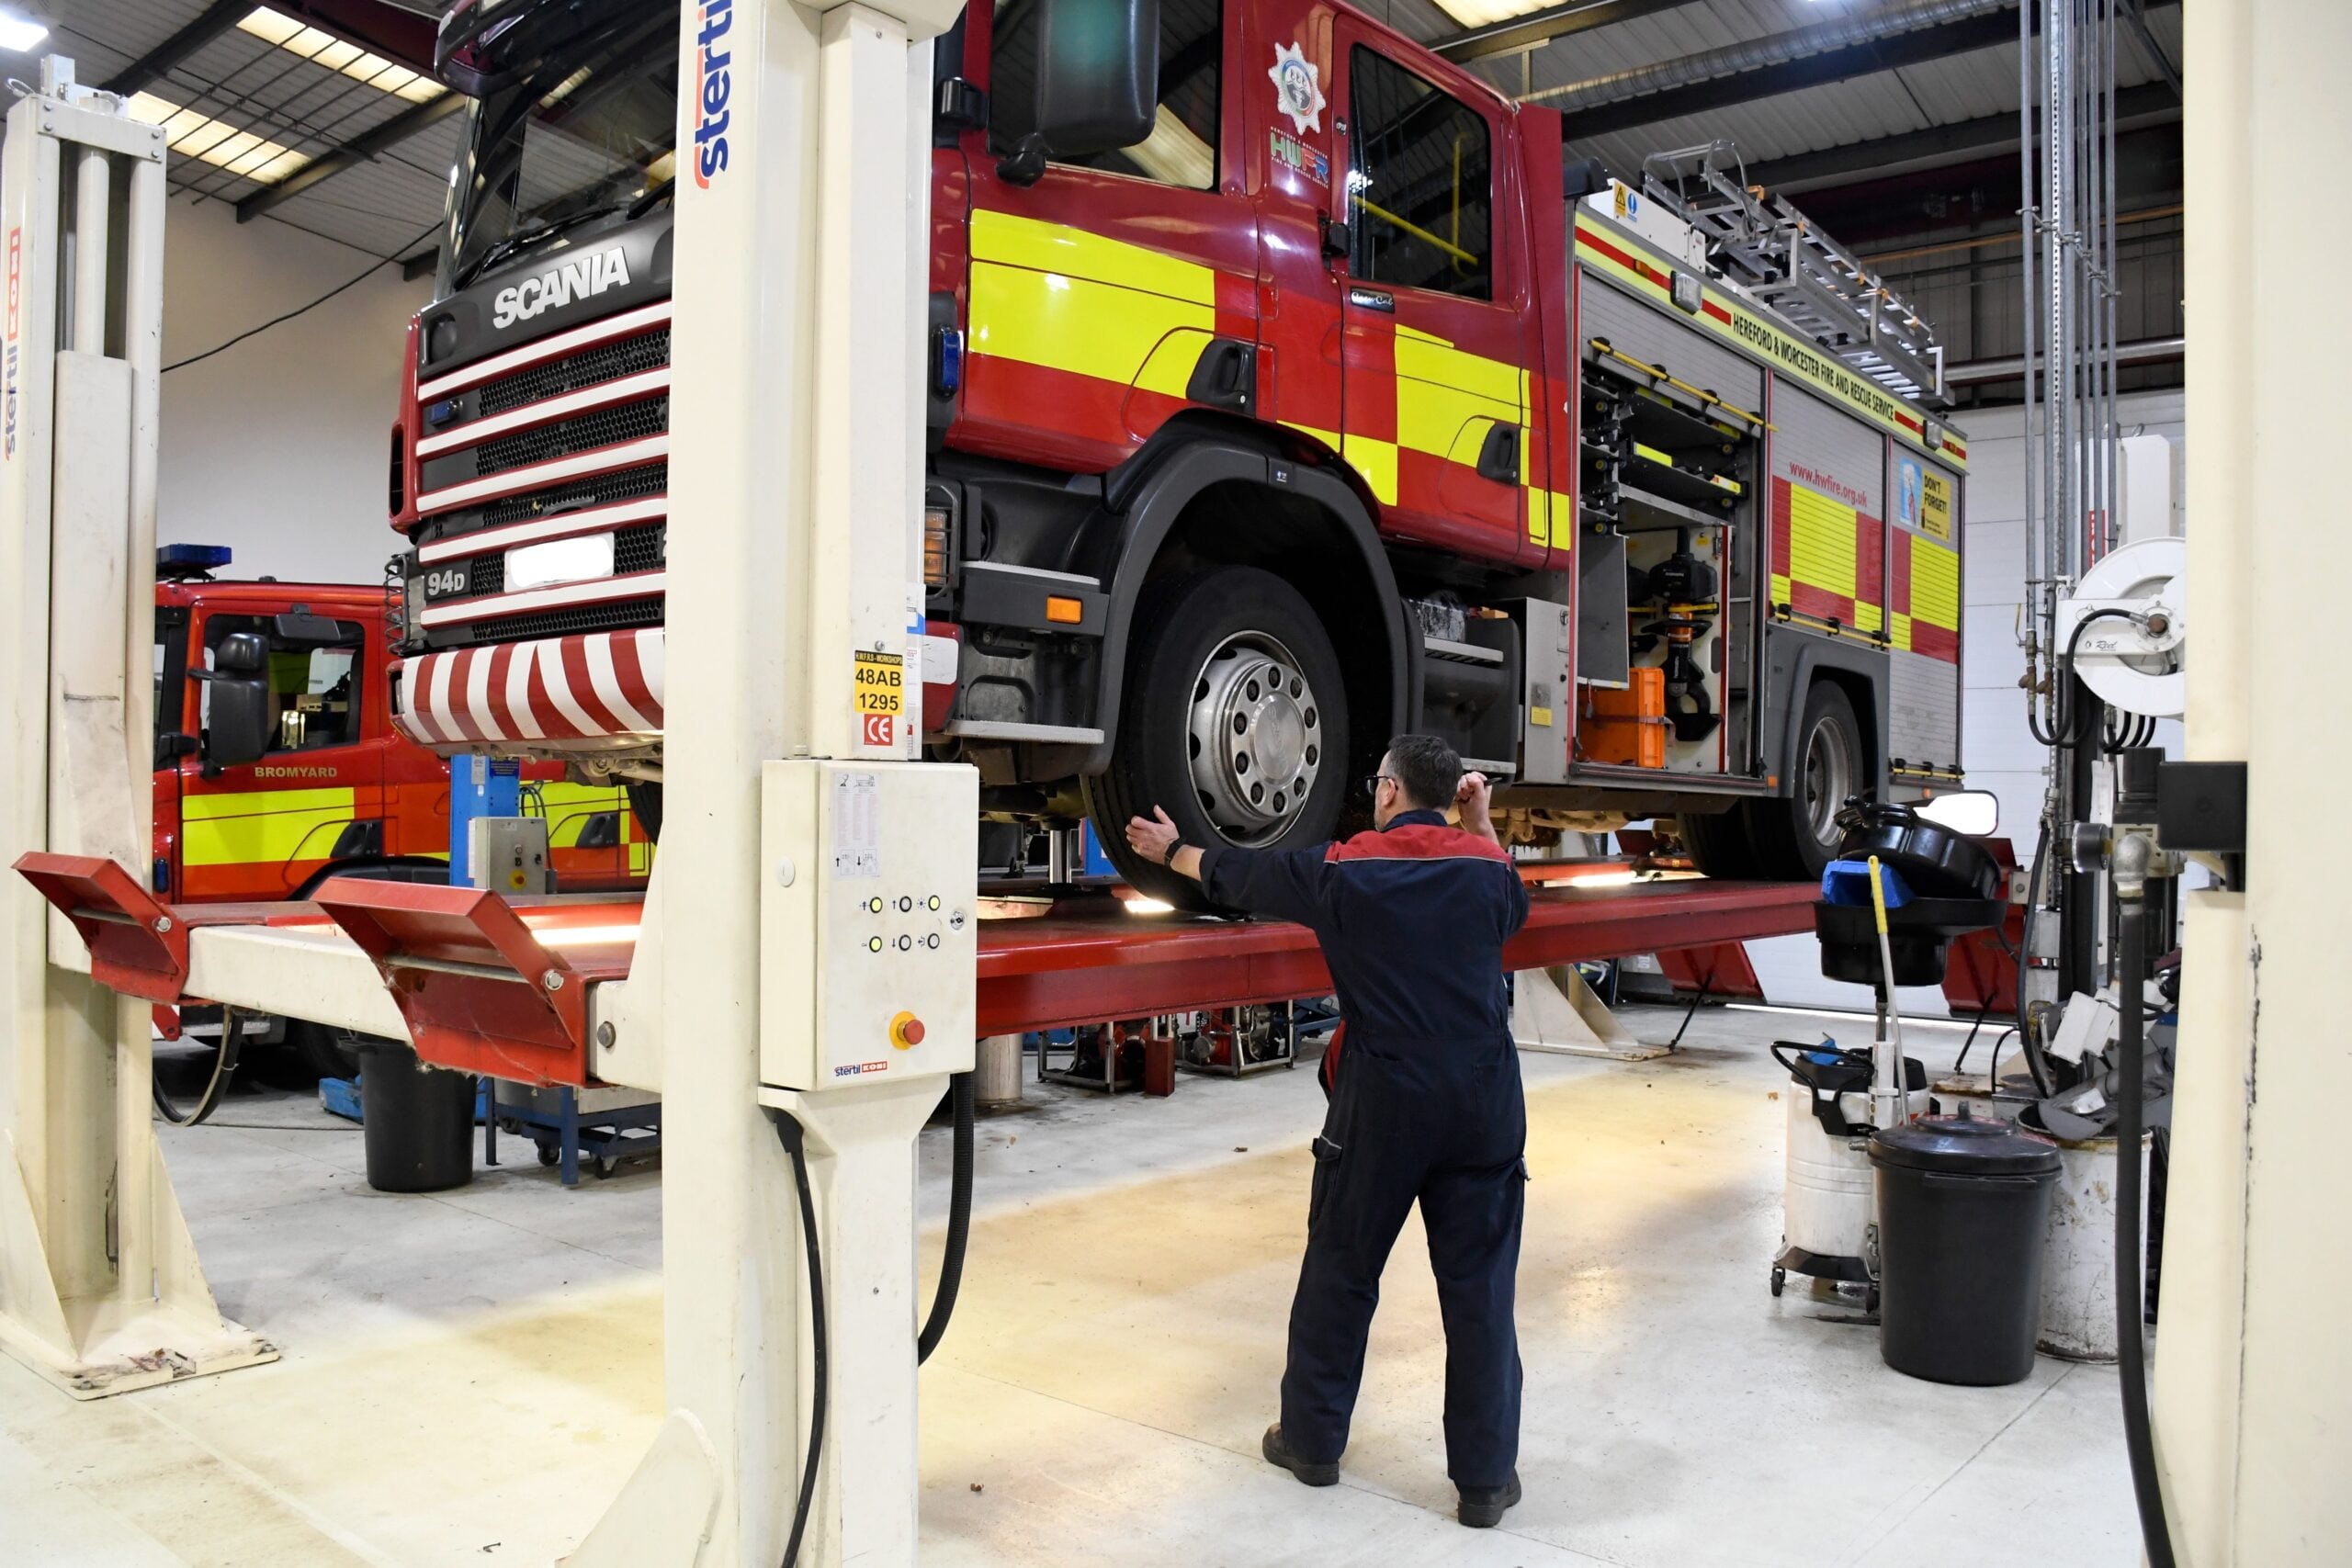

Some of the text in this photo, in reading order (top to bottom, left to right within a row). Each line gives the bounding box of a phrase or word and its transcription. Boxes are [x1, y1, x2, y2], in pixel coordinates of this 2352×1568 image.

[695, 0, 732, 183] sterti
[1271, 131, 1329, 184] HWFR
[492, 246, 631, 330] SCANIA
[1733, 313, 1894, 422] HEREFORD & WORCESTER FIRE AND RESCUE SERVICE
[6, 345, 18, 458] stertil
[1790, 461, 1867, 507] www.hwfire.org.uk
[1924, 474, 1940, 495] DON'T
[1924, 491, 1947, 515] FORGET!
[427, 570, 465, 596] 94D
[855, 668, 901, 687] 48AB
[859, 693, 899, 711] 1295
[867, 716, 890, 743] CE
[254, 766, 338, 778] BROMYARD
[834, 1065, 861, 1077] stertil
